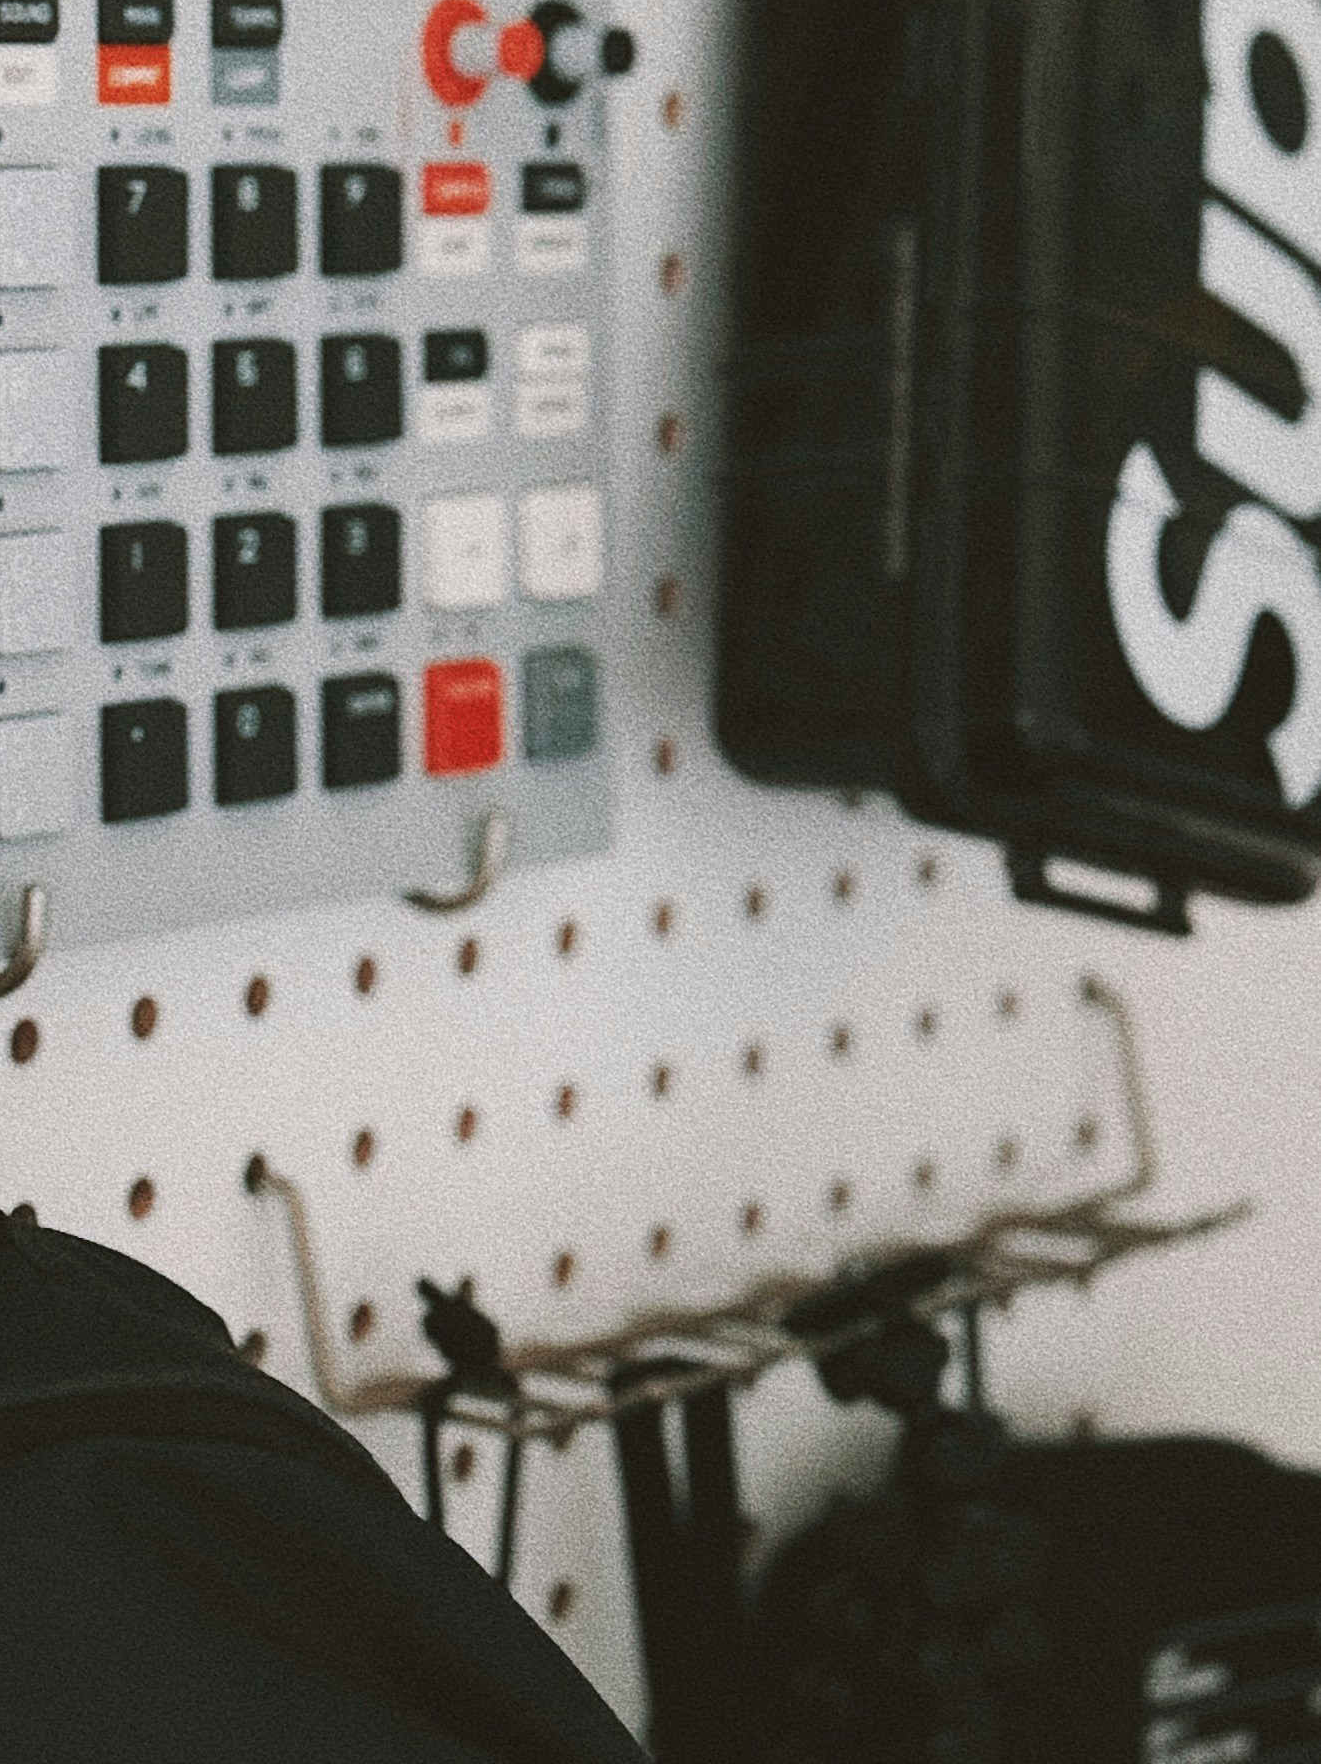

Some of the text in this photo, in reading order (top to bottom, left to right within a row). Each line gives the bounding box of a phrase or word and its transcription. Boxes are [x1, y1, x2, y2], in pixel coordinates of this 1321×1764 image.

[127, 178, 149, 216] 7
[343, 173, 368, 210] 9
[125, 359, 150, 394] 4
[235, 349, 260, 388] 5
[236, 526, 261, 565] 2
[346, 518, 369, 557] 3
